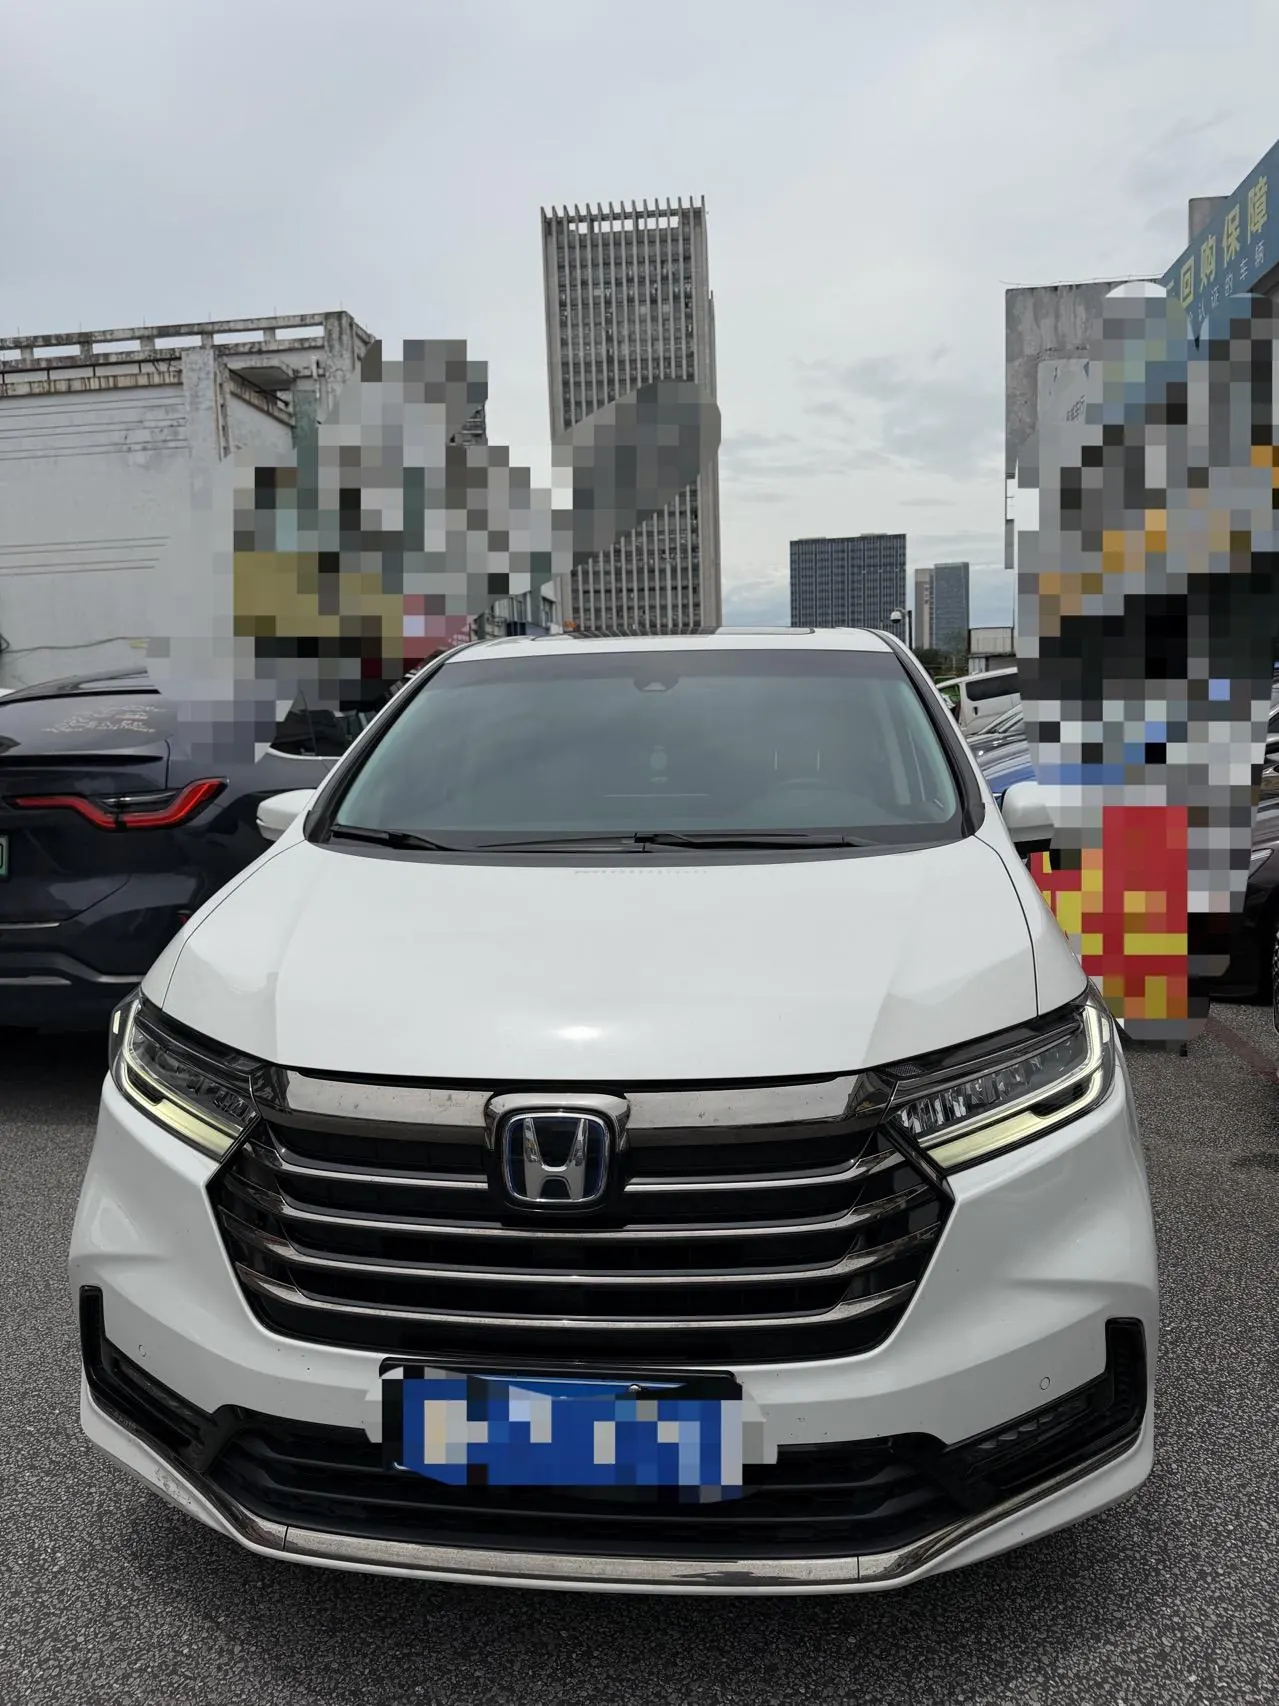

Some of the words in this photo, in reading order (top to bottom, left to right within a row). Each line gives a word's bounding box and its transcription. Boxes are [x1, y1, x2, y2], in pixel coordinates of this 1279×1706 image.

[1181, 175, 1268, 310] 回购保障
[1188, 239, 1265, 321] 认证的车辆
